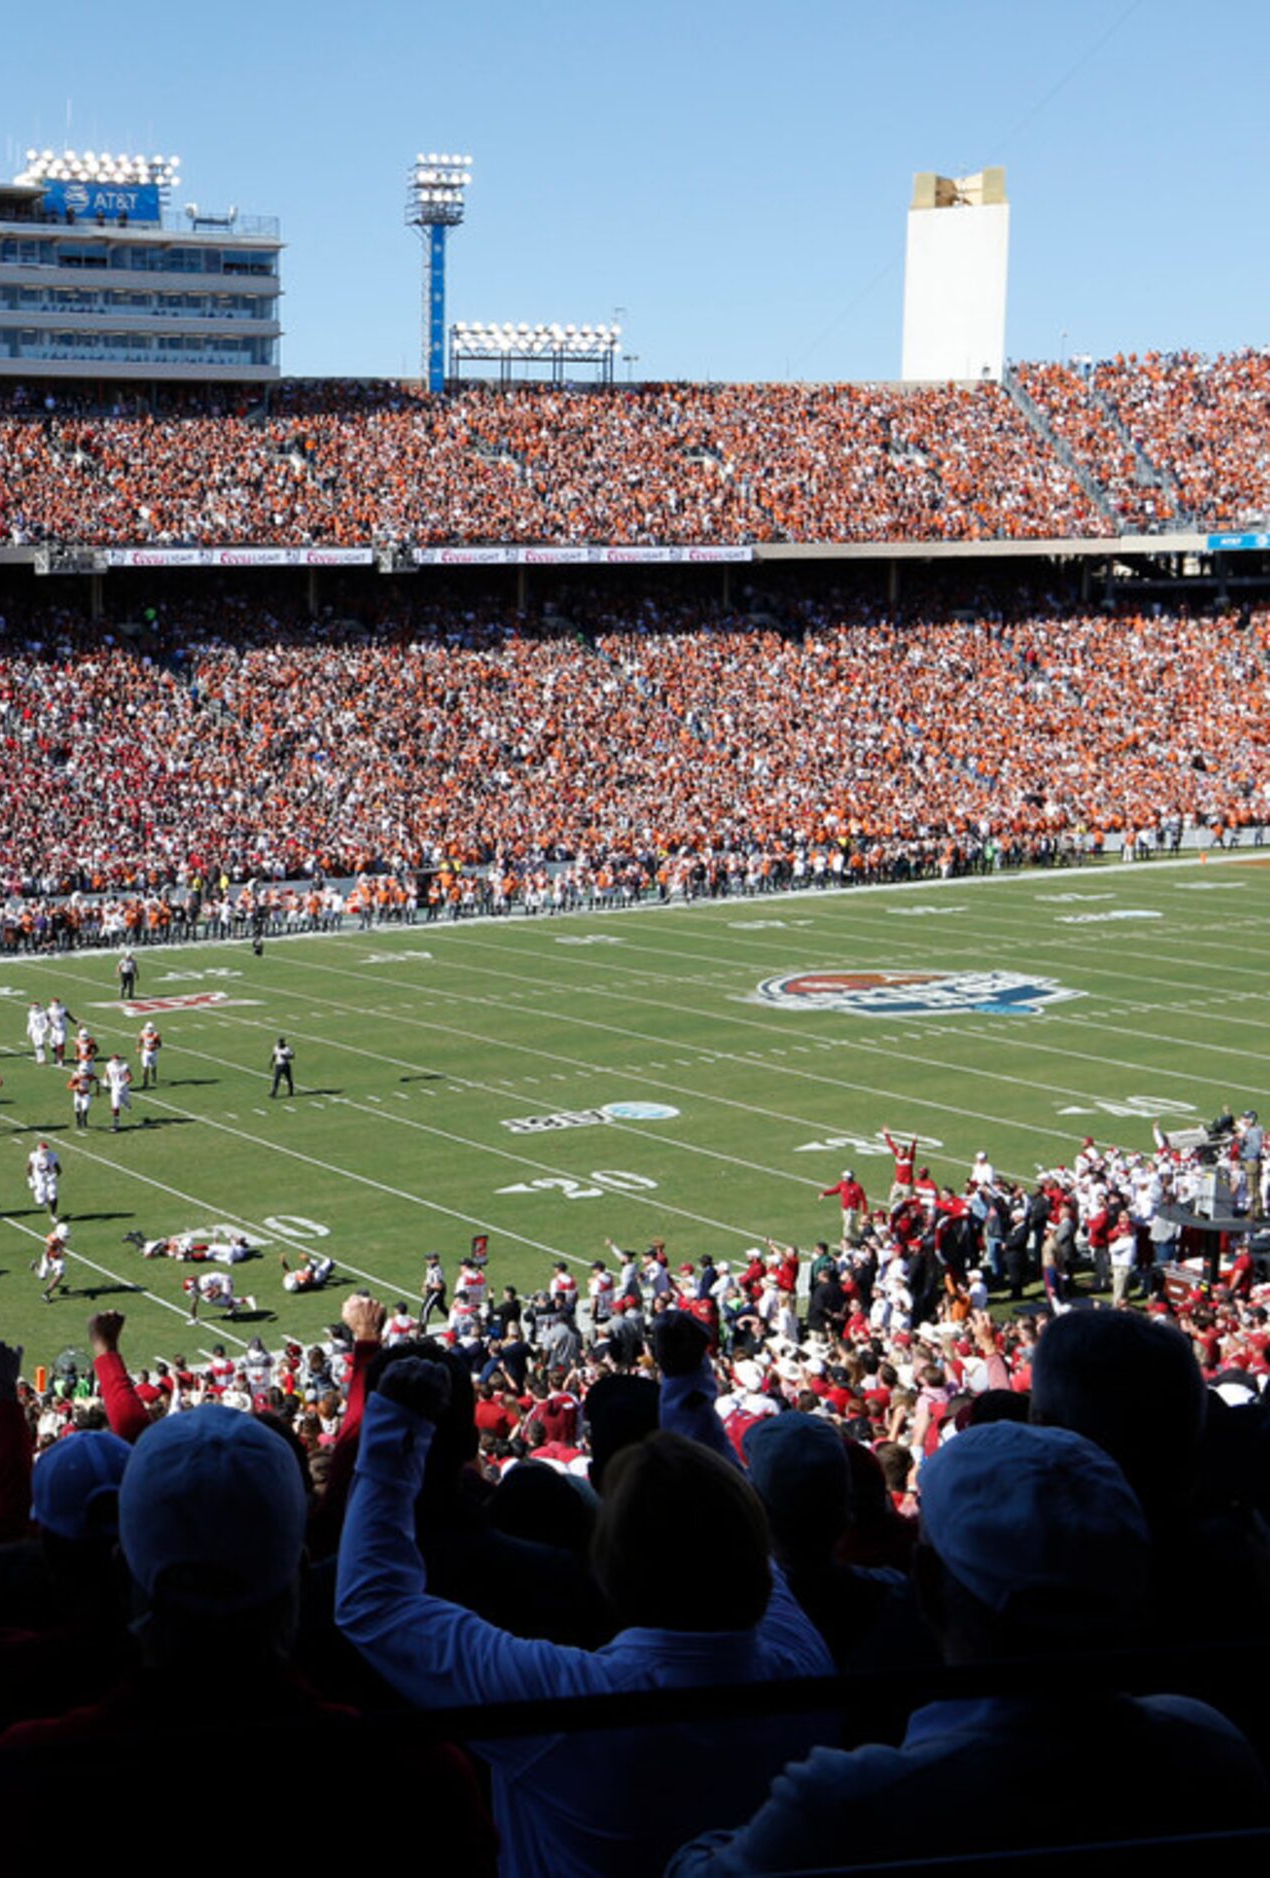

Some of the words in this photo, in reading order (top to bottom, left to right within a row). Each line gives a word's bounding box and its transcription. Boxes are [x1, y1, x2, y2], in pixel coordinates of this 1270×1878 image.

[93, 192, 139, 210] AT&T
[1095, 1095, 1198, 1119] 40
[824, 1130, 946, 1155] 30
[531, 1169, 659, 1200] 20
